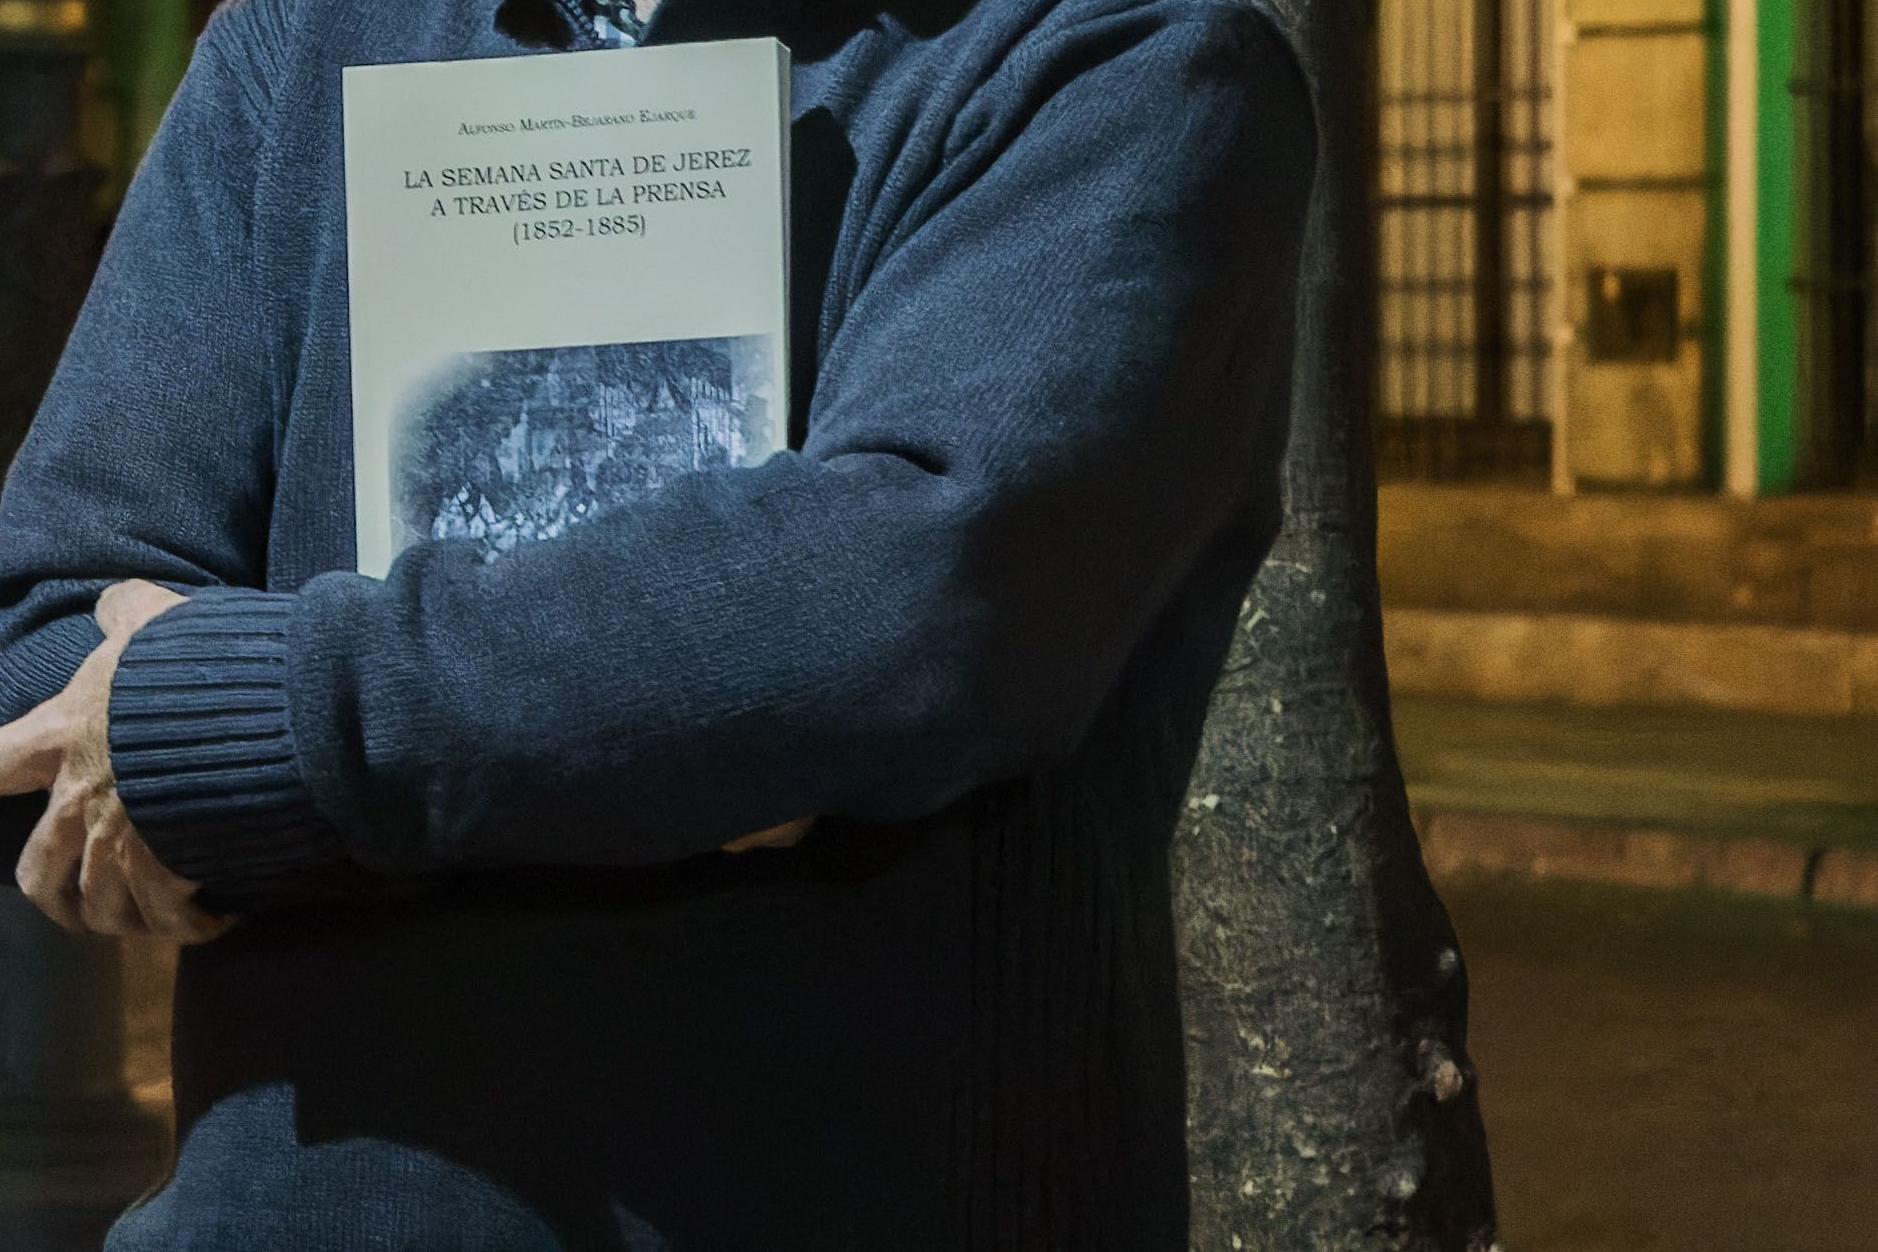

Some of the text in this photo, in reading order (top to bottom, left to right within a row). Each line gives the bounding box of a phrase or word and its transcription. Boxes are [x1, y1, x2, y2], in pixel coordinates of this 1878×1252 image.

[404, 148, 753, 189] LA SEMANA SANTA DE JEREZ
[430, 179, 727, 217] A TRAVÉS DE LA PRENSA
[513, 213, 646, 246] (1852-1885)
